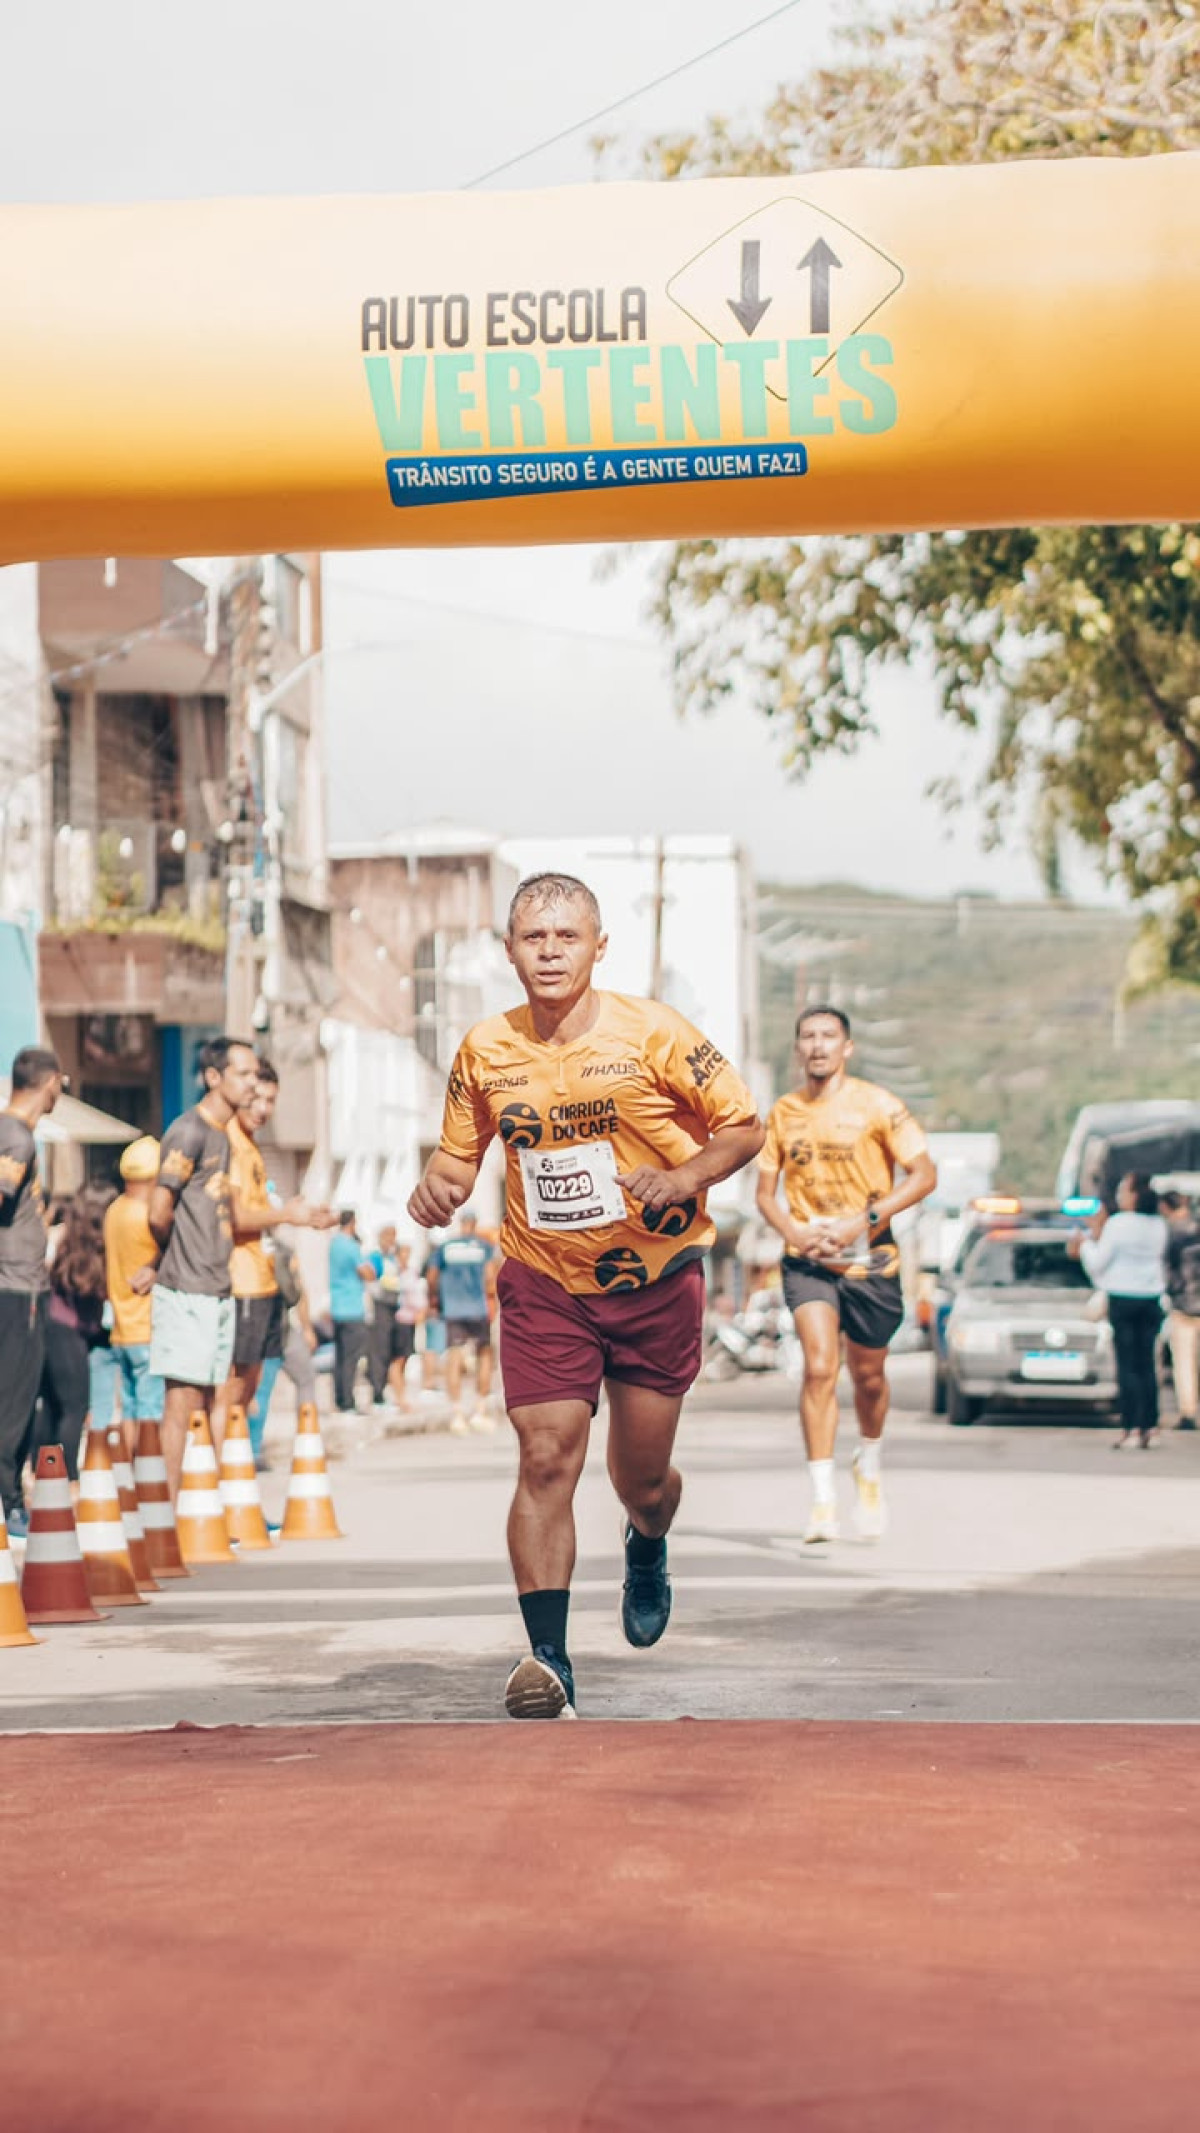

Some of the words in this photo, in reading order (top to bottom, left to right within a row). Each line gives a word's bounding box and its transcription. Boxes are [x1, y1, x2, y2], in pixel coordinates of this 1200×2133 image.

[362, 294, 469, 351] AUTO
[486, 286, 647, 347] ESCOLA
[364, 333, 898, 452] VERTENTES
[393, 461, 492, 487] TRÂNSITO
[497, 461, 578, 483] SEGURO
[584, 455, 597, 480] É
[603, 459, 618, 480] A
[622, 457, 688, 479] GENTE
[694, 454, 751, 476] QUEM
[757, 452, 801, 473] FAZ!
[549, 1098, 616, 1121] CORRIDA
[553, 1123, 576, 1142] DO
[538, 1174, 592, 1199] 10229
